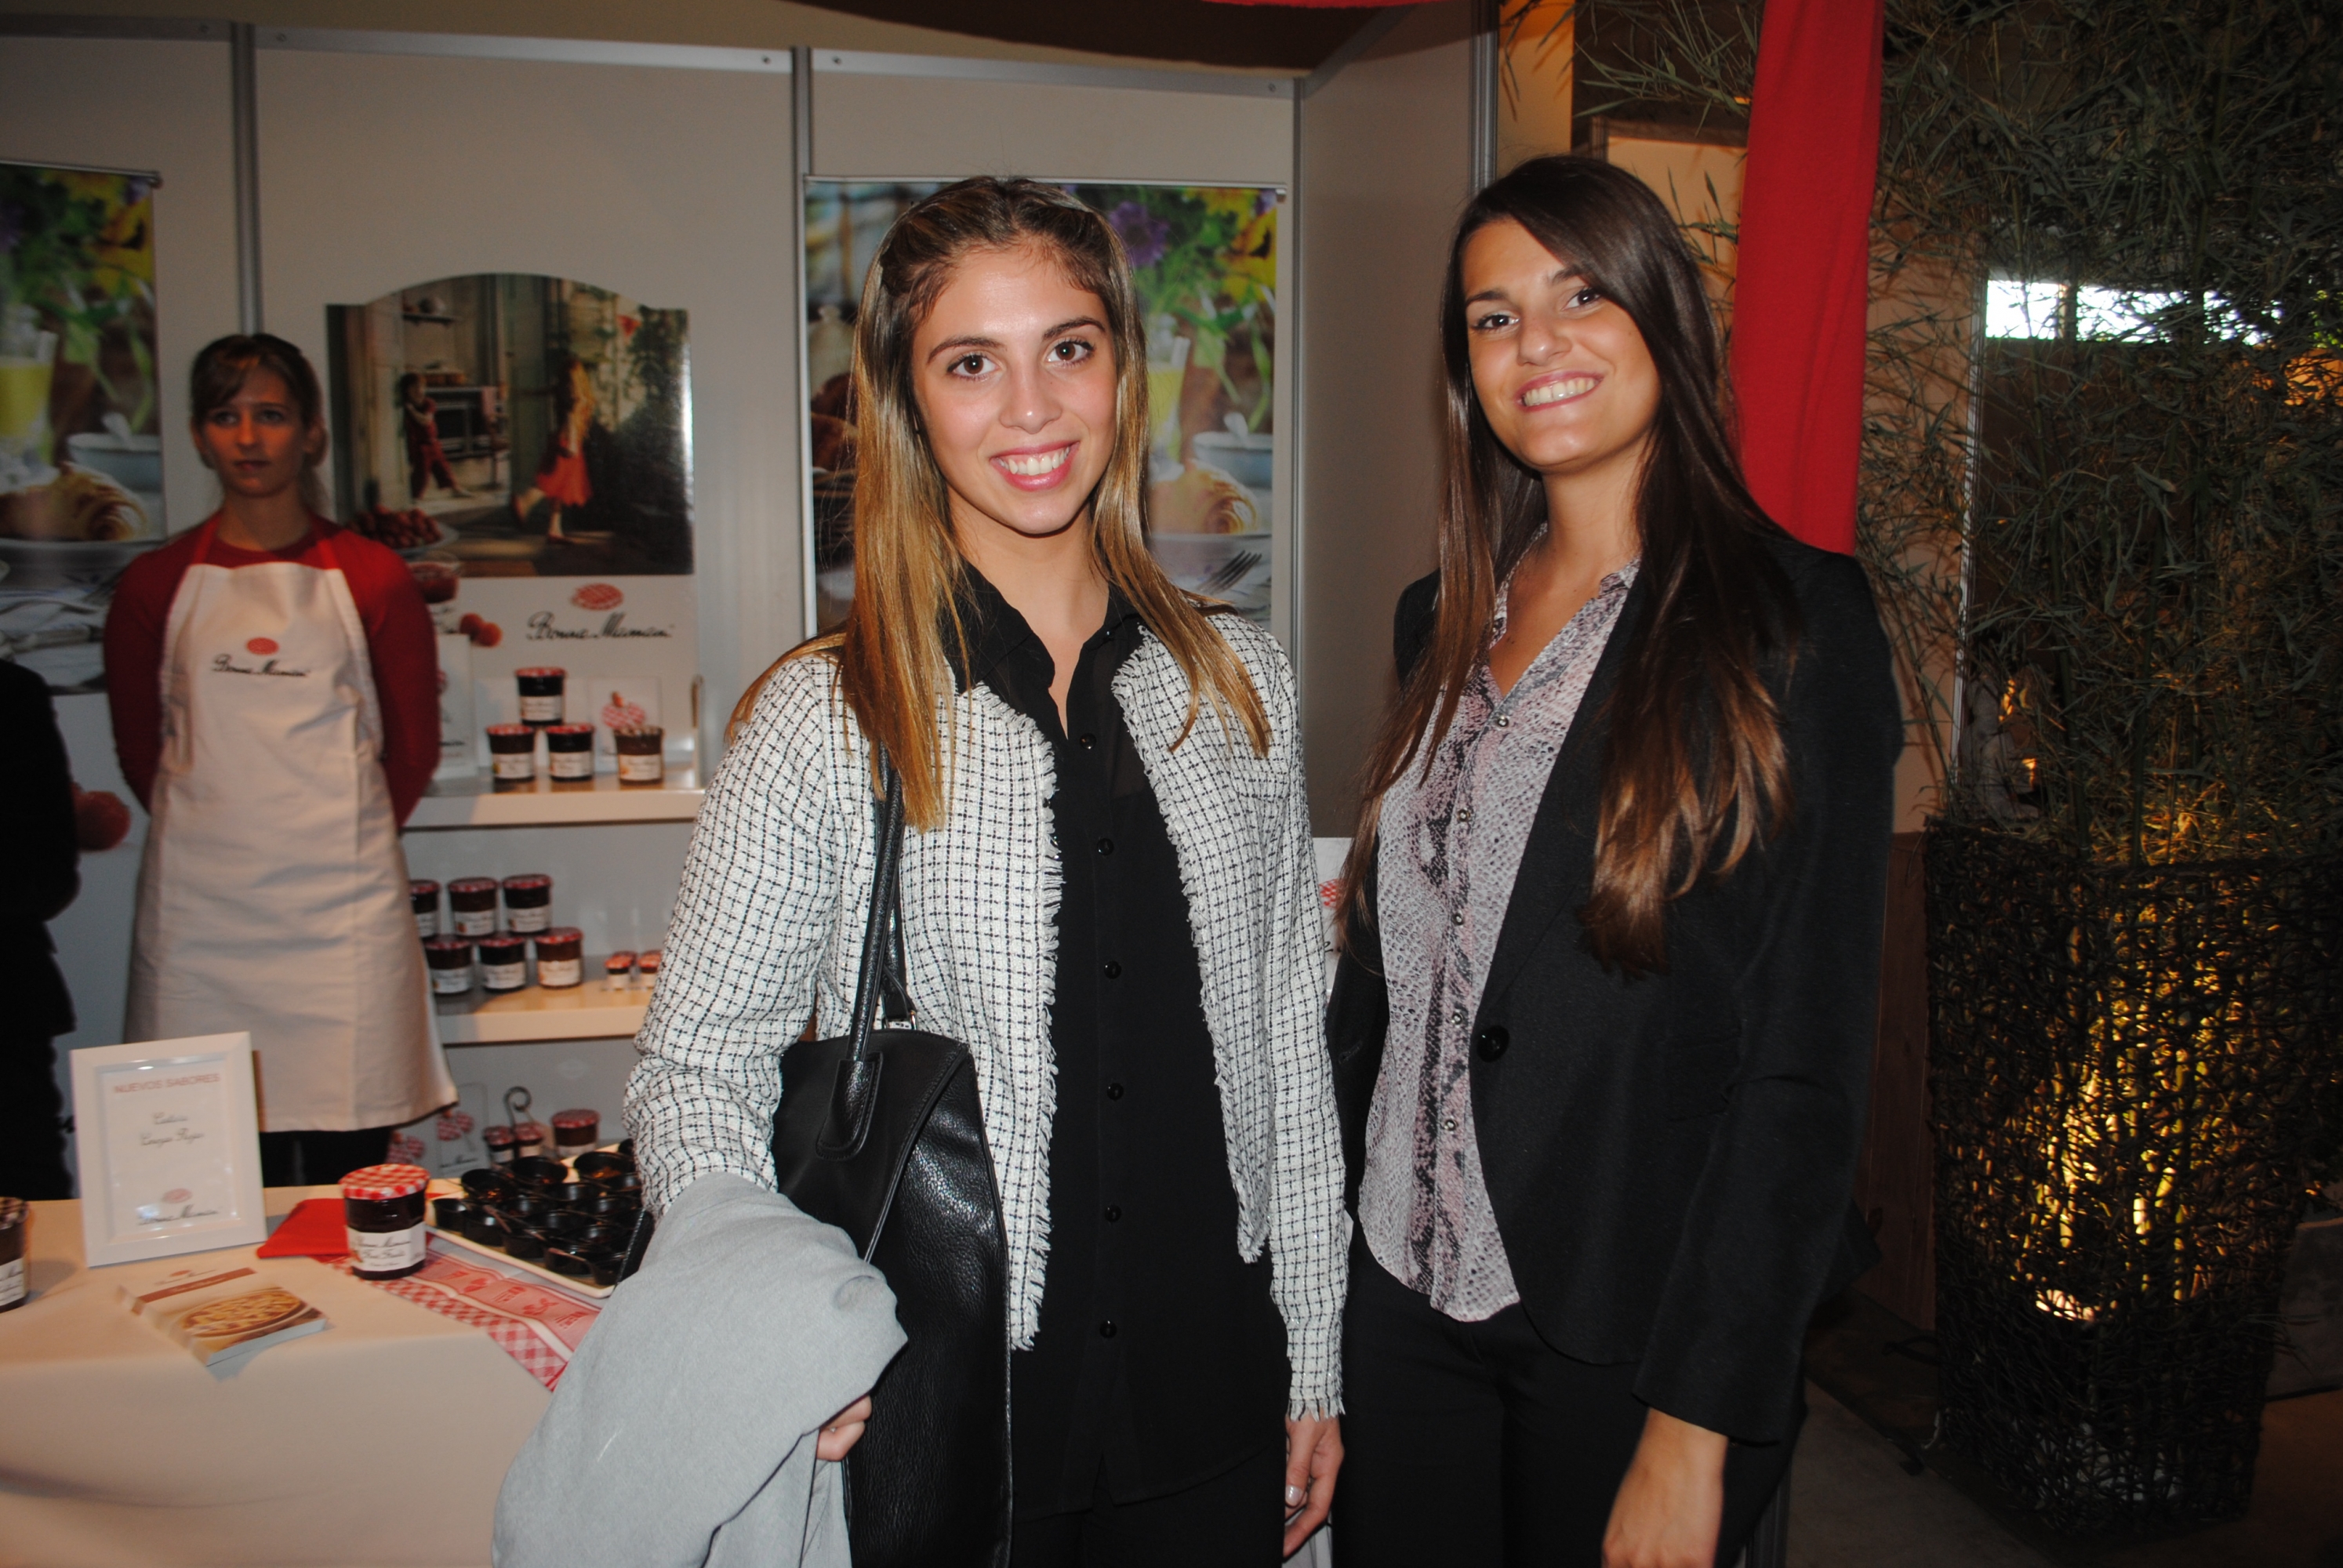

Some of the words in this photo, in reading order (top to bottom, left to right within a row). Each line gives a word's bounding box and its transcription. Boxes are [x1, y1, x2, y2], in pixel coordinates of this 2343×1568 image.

[526, 611, 589, 640] Bonne
[594, 612, 674, 638] Maman
[114, 1080, 163, 1094] NUEVOS
[166, 1073, 220, 1087] SABORES
